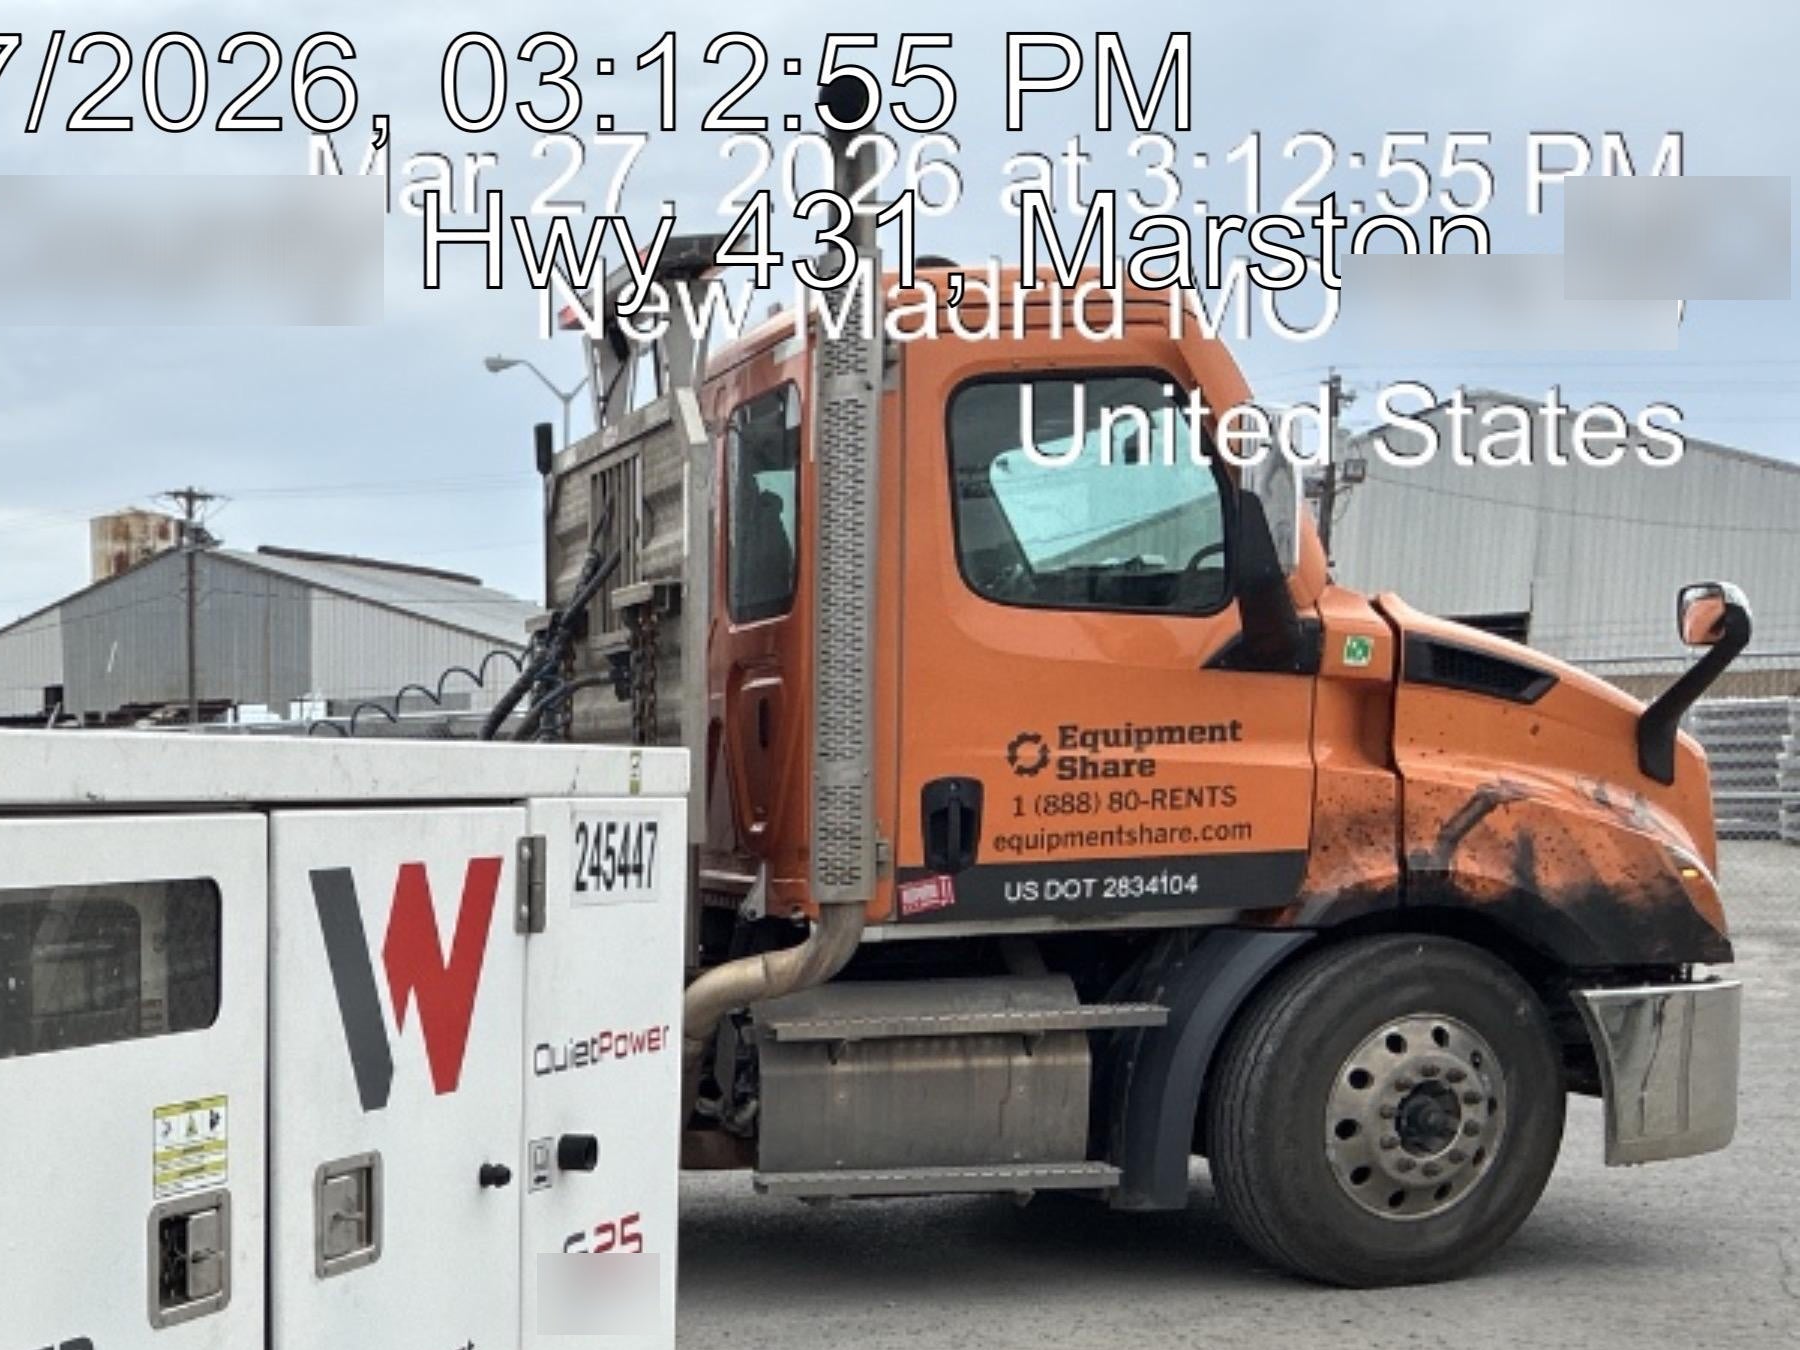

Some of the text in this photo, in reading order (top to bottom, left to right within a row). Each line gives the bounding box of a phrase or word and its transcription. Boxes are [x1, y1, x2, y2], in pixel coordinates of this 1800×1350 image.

[1058, 719, 1243, 753] Equipment
[1056, 755, 1157, 782] Share
[1012, 784, 1238, 817] 1 (888) 80-RENTS
[992, 822, 1253, 856] equipmentshare.com
[574, 820, 658, 893] 245447
[1004, 866, 1199, 902] US DOT 2834104
[533, 1023, 670, 1077] QuietPower
